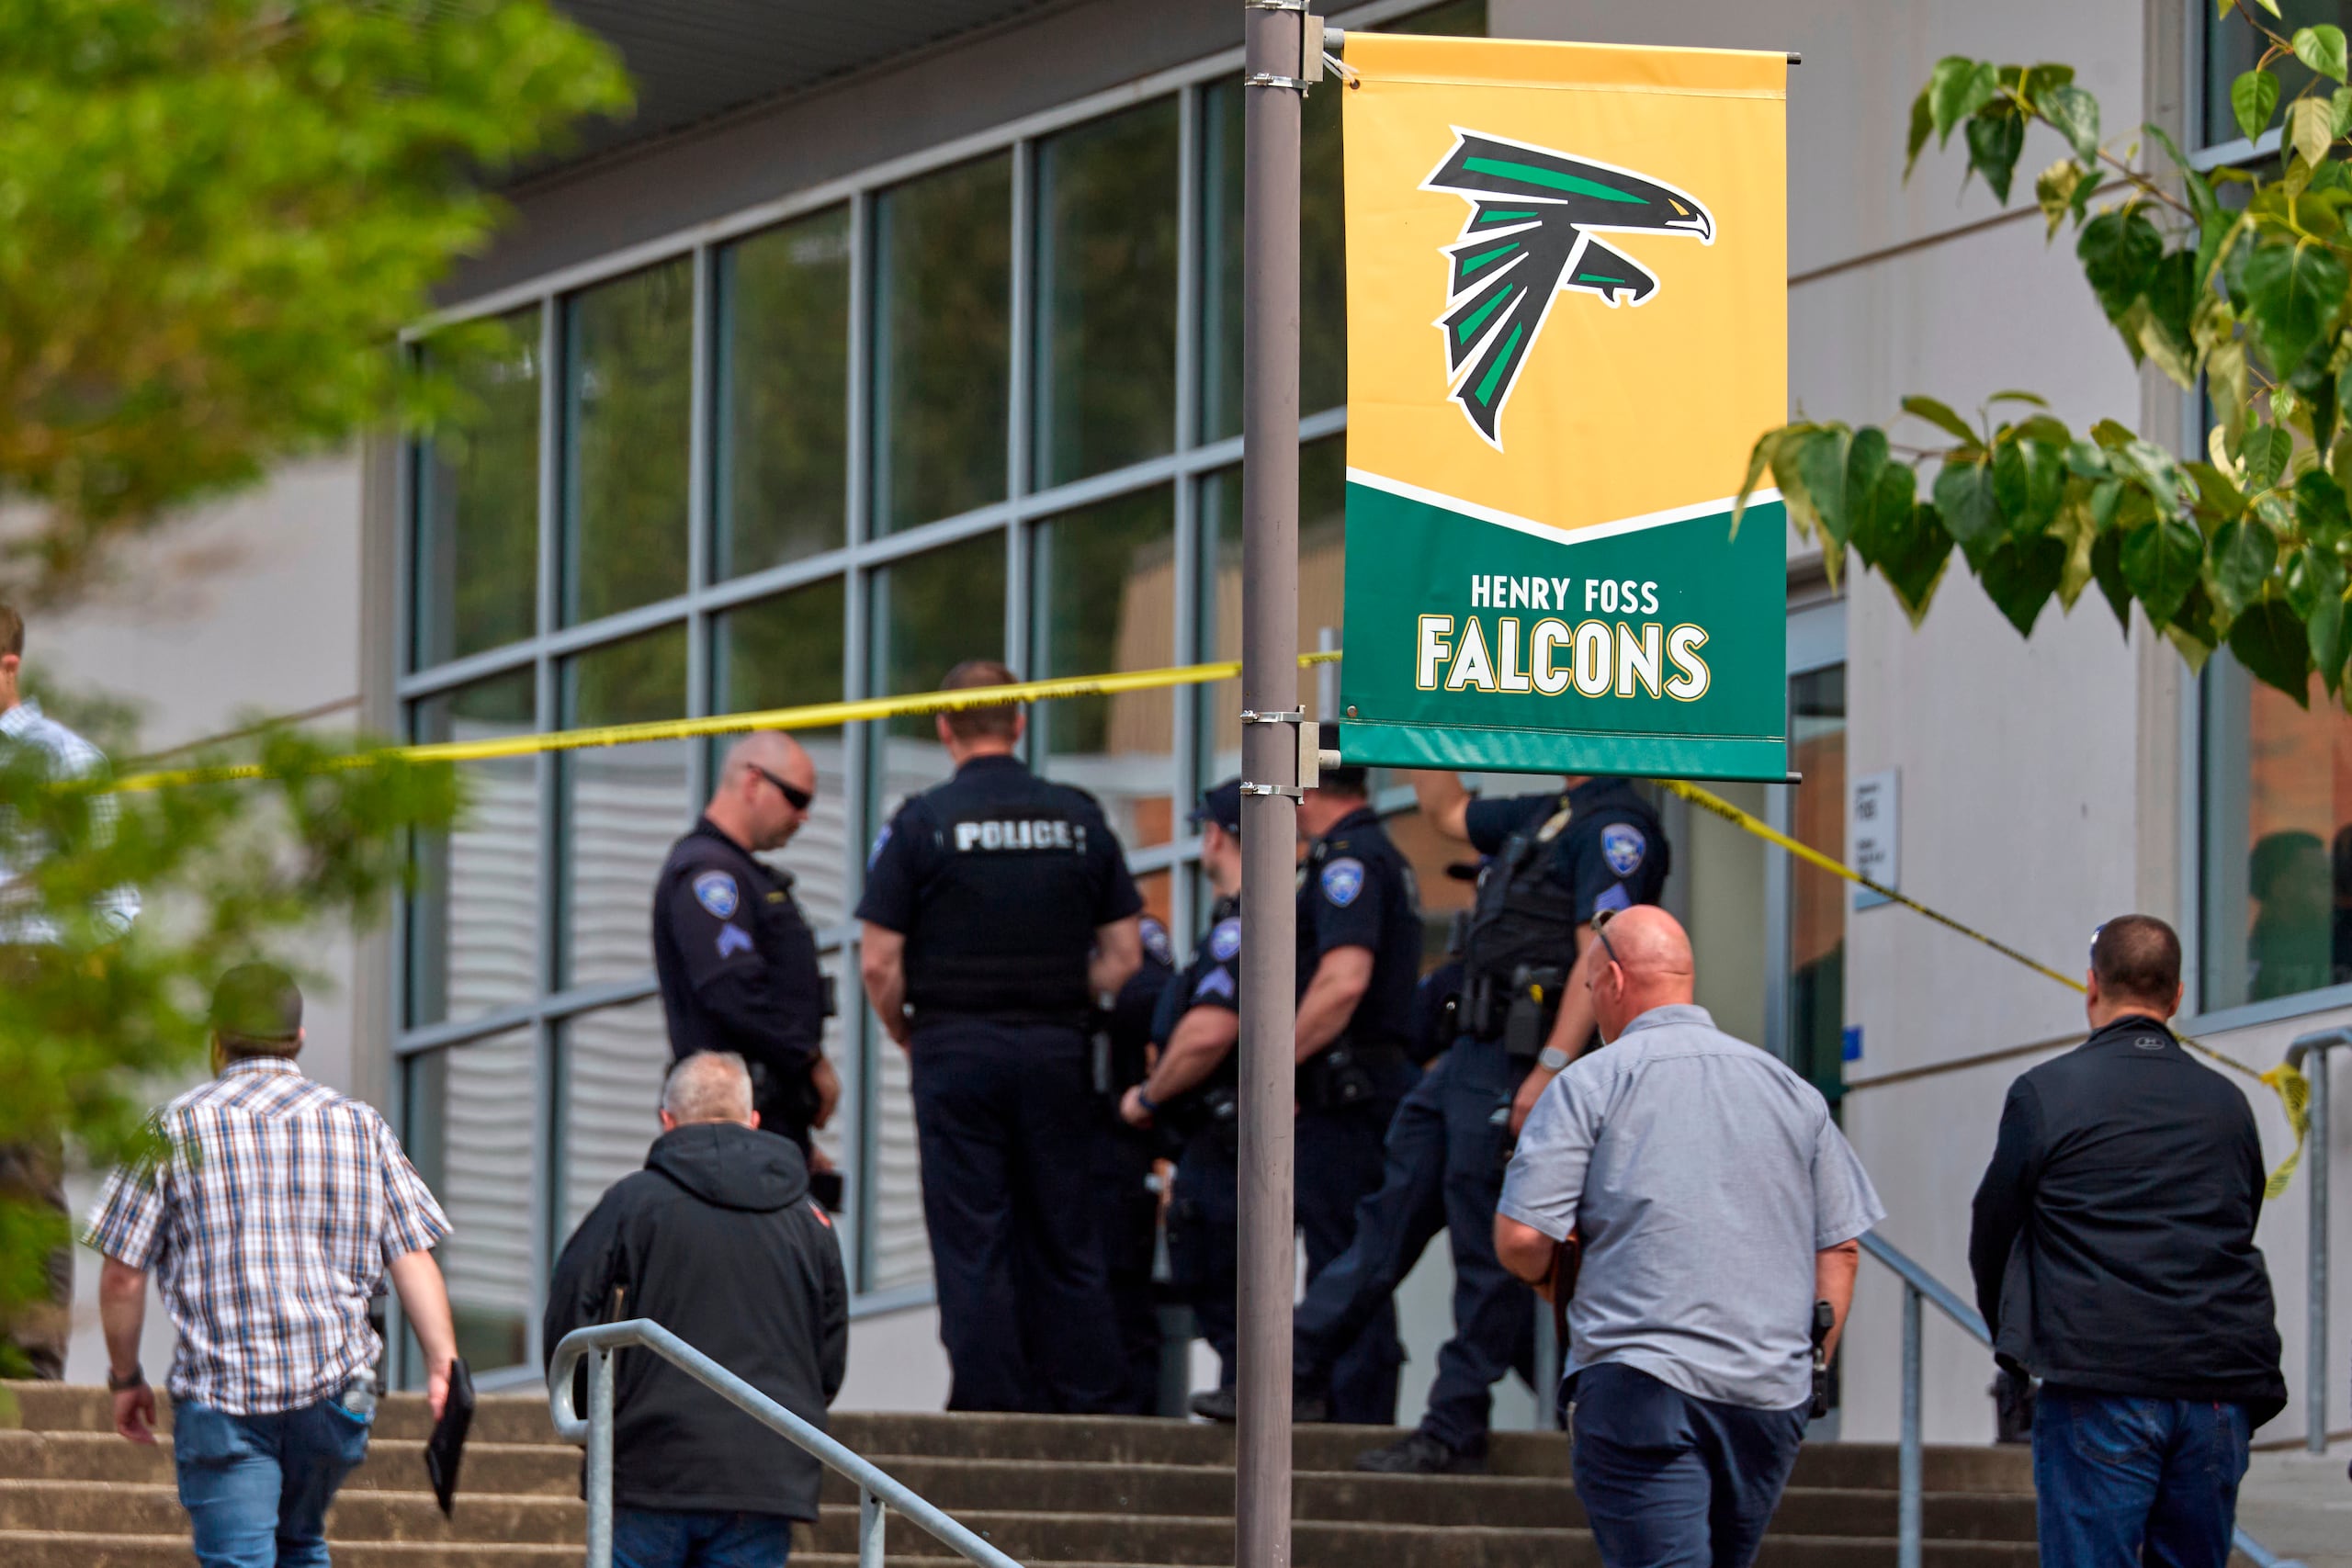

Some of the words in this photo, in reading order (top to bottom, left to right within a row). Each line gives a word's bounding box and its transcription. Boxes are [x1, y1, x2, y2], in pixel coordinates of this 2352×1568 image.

[1472, 575, 1570, 610] HENRY
[1585, 580, 1659, 614] FOSS
[1416, 615, 1711, 702] FALCONS
[955, 819, 1073, 851] POLICE
